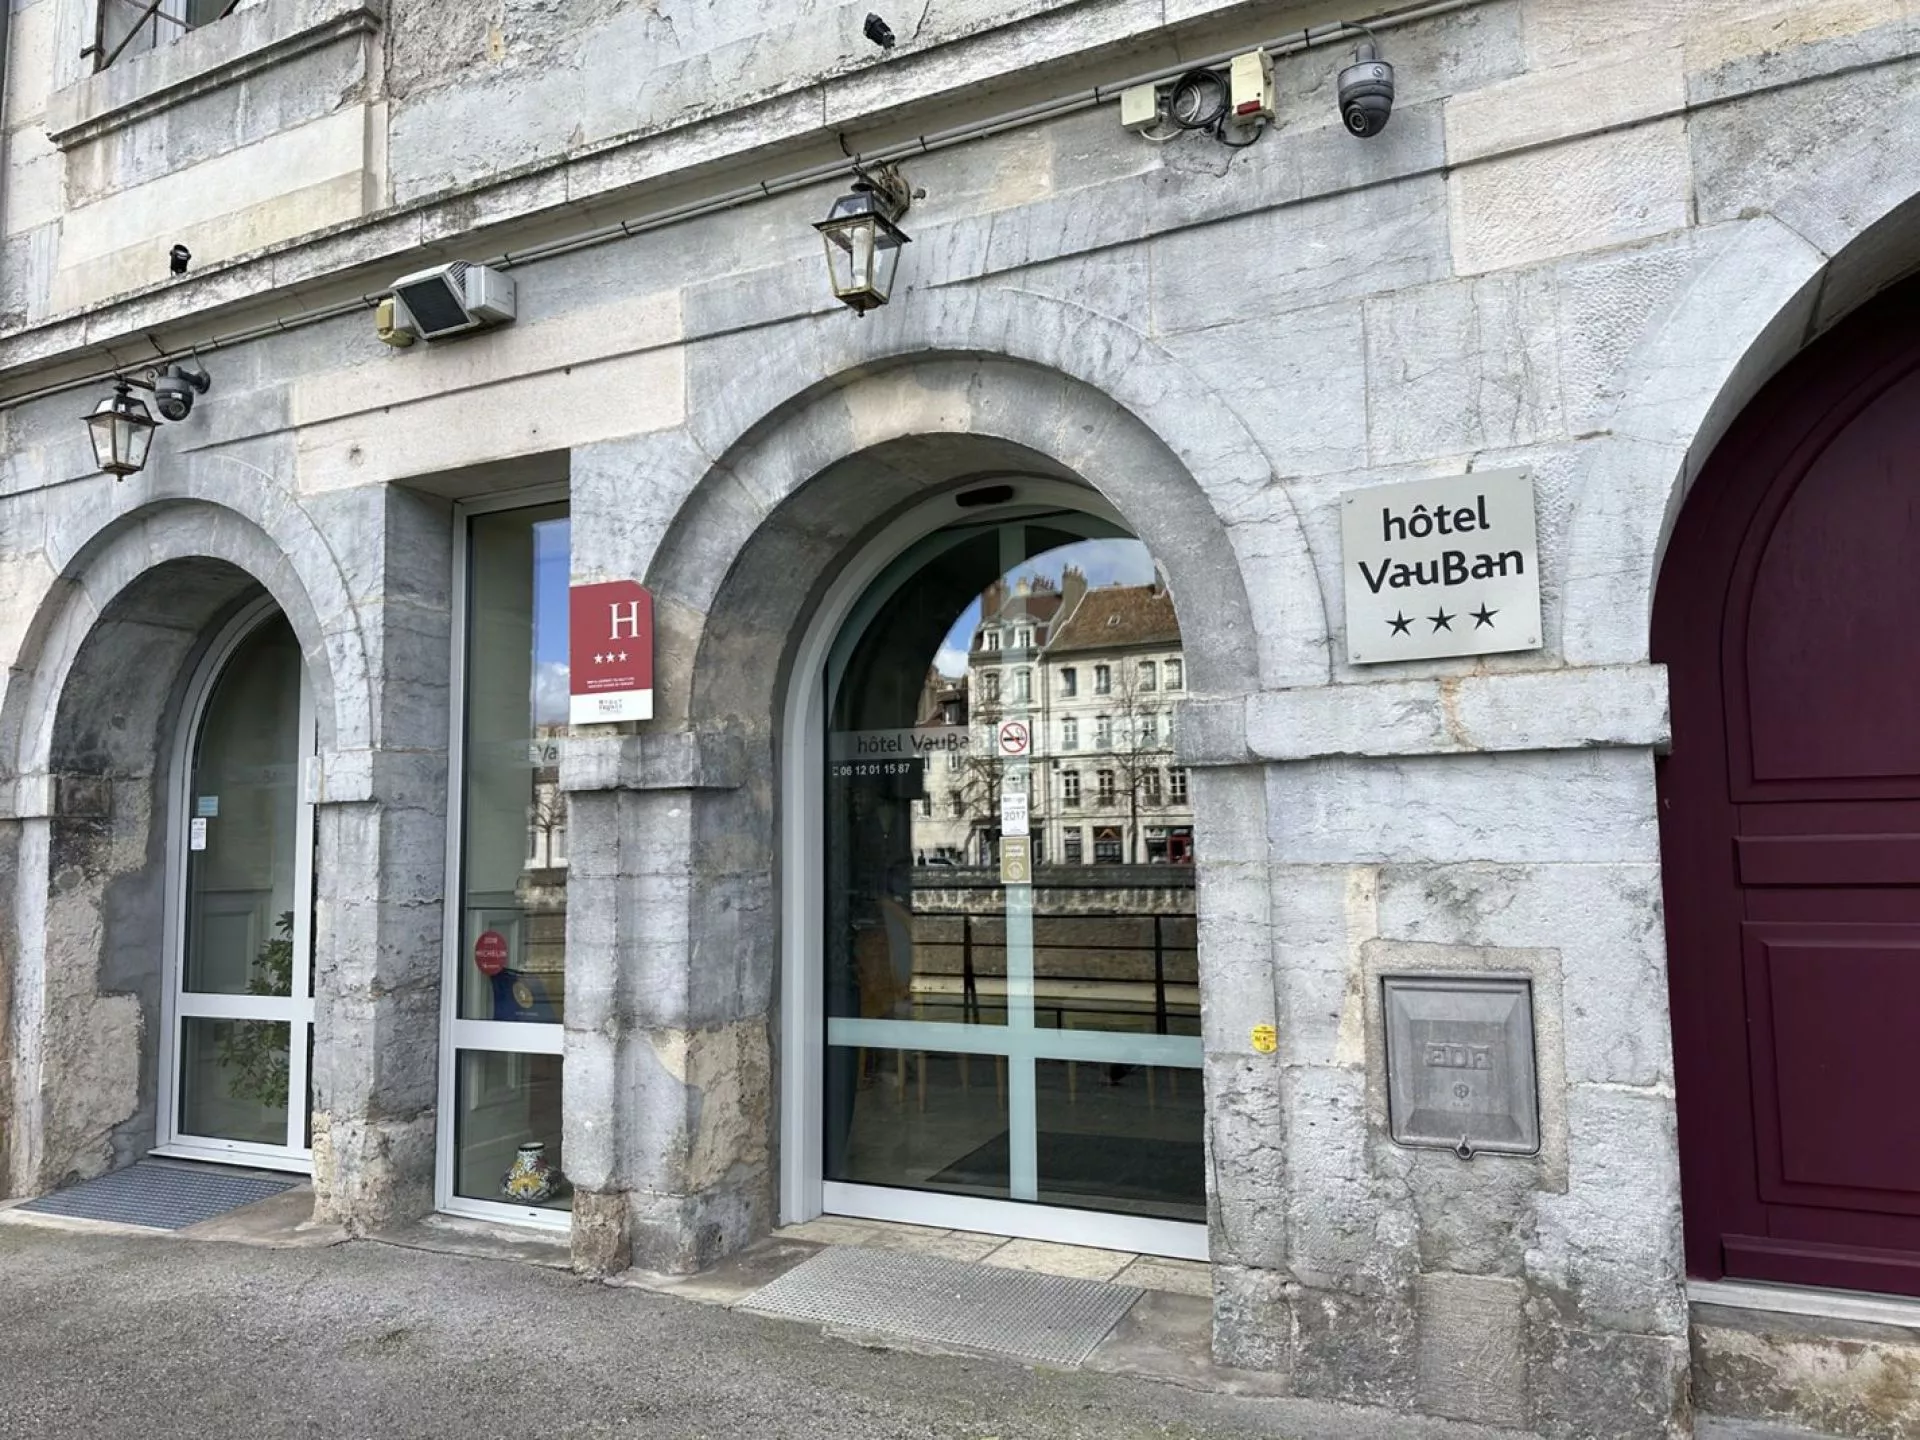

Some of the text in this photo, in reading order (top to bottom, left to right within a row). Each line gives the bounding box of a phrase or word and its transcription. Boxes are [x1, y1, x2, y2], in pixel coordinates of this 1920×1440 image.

[1383, 495, 1490, 541] hôtel
[1358, 550, 1524, 594] VauBan
[609, 600, 641, 640] H
[857, 734, 903, 755] hôtel
[840, 763, 911, 776] 06 12 01 15 87
[1003, 811, 1027, 821] 2017
[1422, 1041, 1493, 1071] EDF
